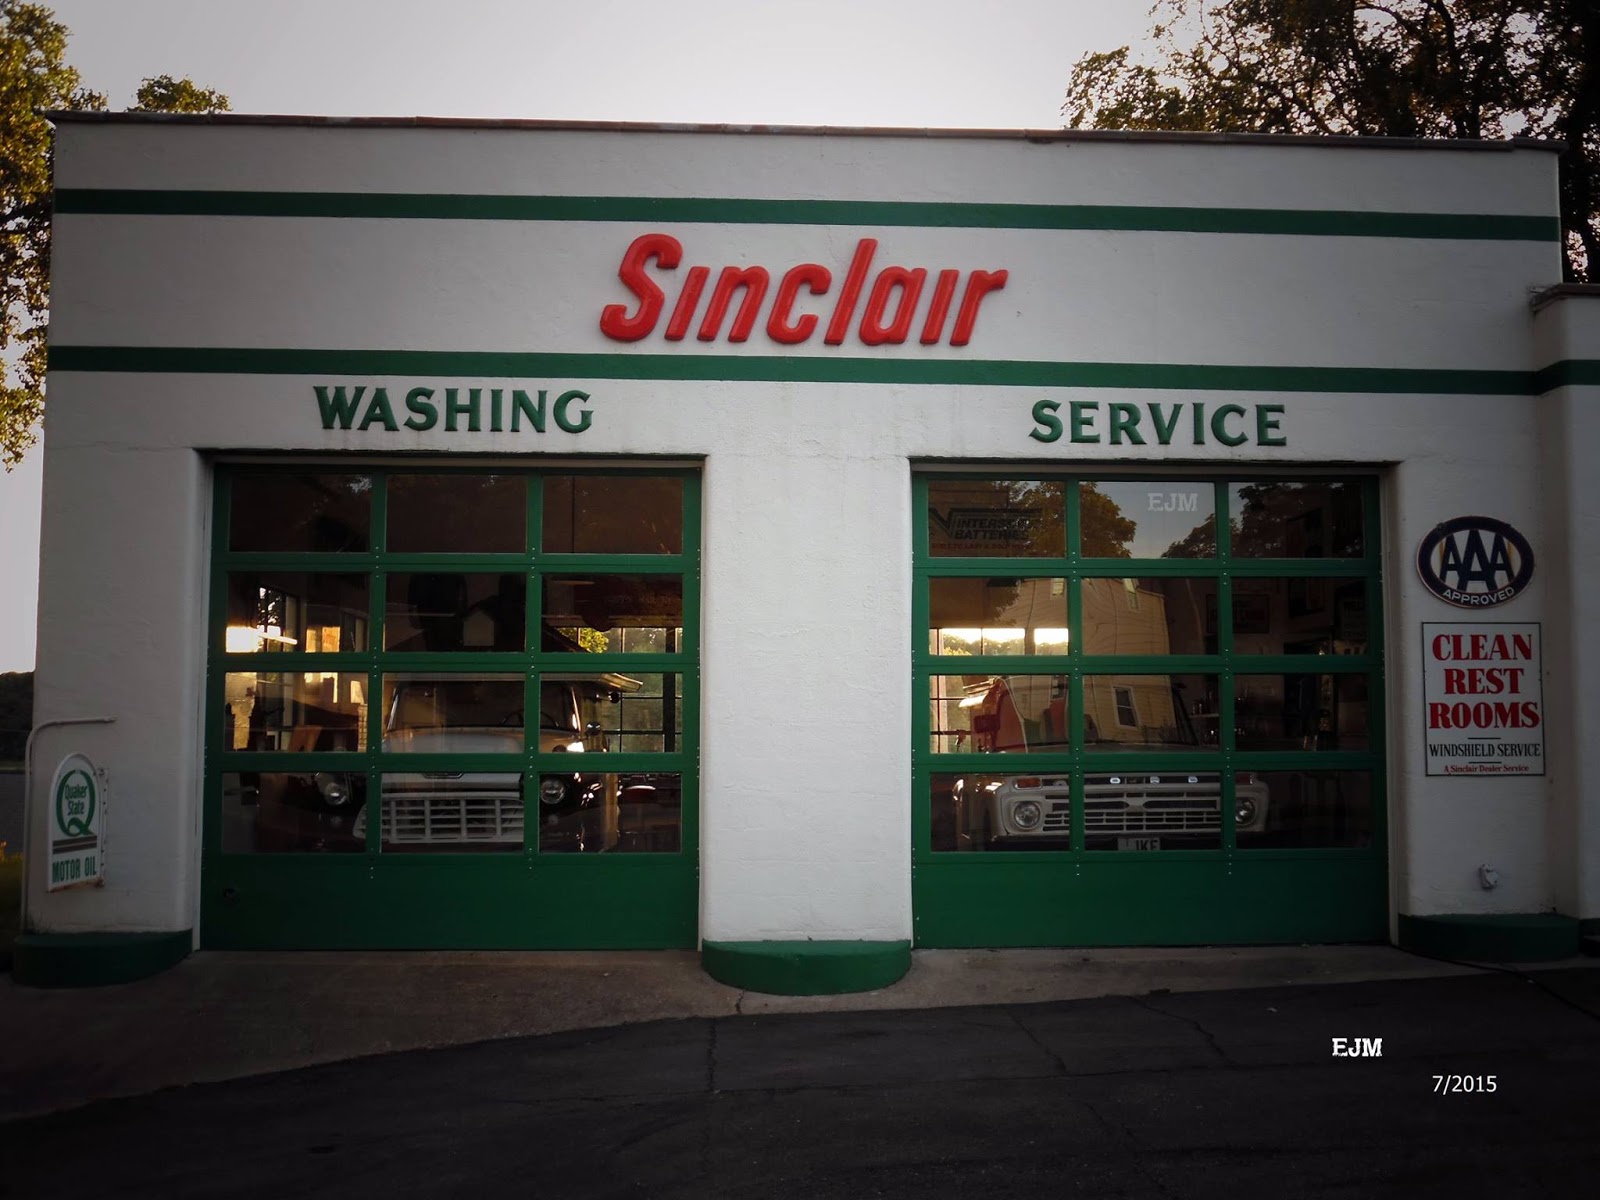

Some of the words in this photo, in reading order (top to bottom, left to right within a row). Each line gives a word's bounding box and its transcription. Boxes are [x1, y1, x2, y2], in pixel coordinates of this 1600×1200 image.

[600, 233, 1008, 347] Sinclair
[313, 386, 594, 434] WASHING
[1029, 399, 1287, 447] SERVICE
[1440, 529, 1515, 593] AAA
[1442, 586, 1515, 605] APPROVED
[1432, 634, 1533, 661] CLEAN
[1444, 668, 1525, 695] REST
[1428, 702, 1541, 729] ROOMS
[1429, 743, 1495, 757] WINDSHIELD
[1497, 743, 1541, 757] SERVICE
[1444, 765, 1450, 773] A
[1450, 764, 1478, 773] Sinclair
[1479, 764, 1502, 773] Dealer
[1503, 764, 1530, 773] Service
[64, 784, 88, 800] Quaker
[67, 800, 85, 816] State
[52, 858, 81, 883] MOTOR
[84, 856, 97, 877] OIL
